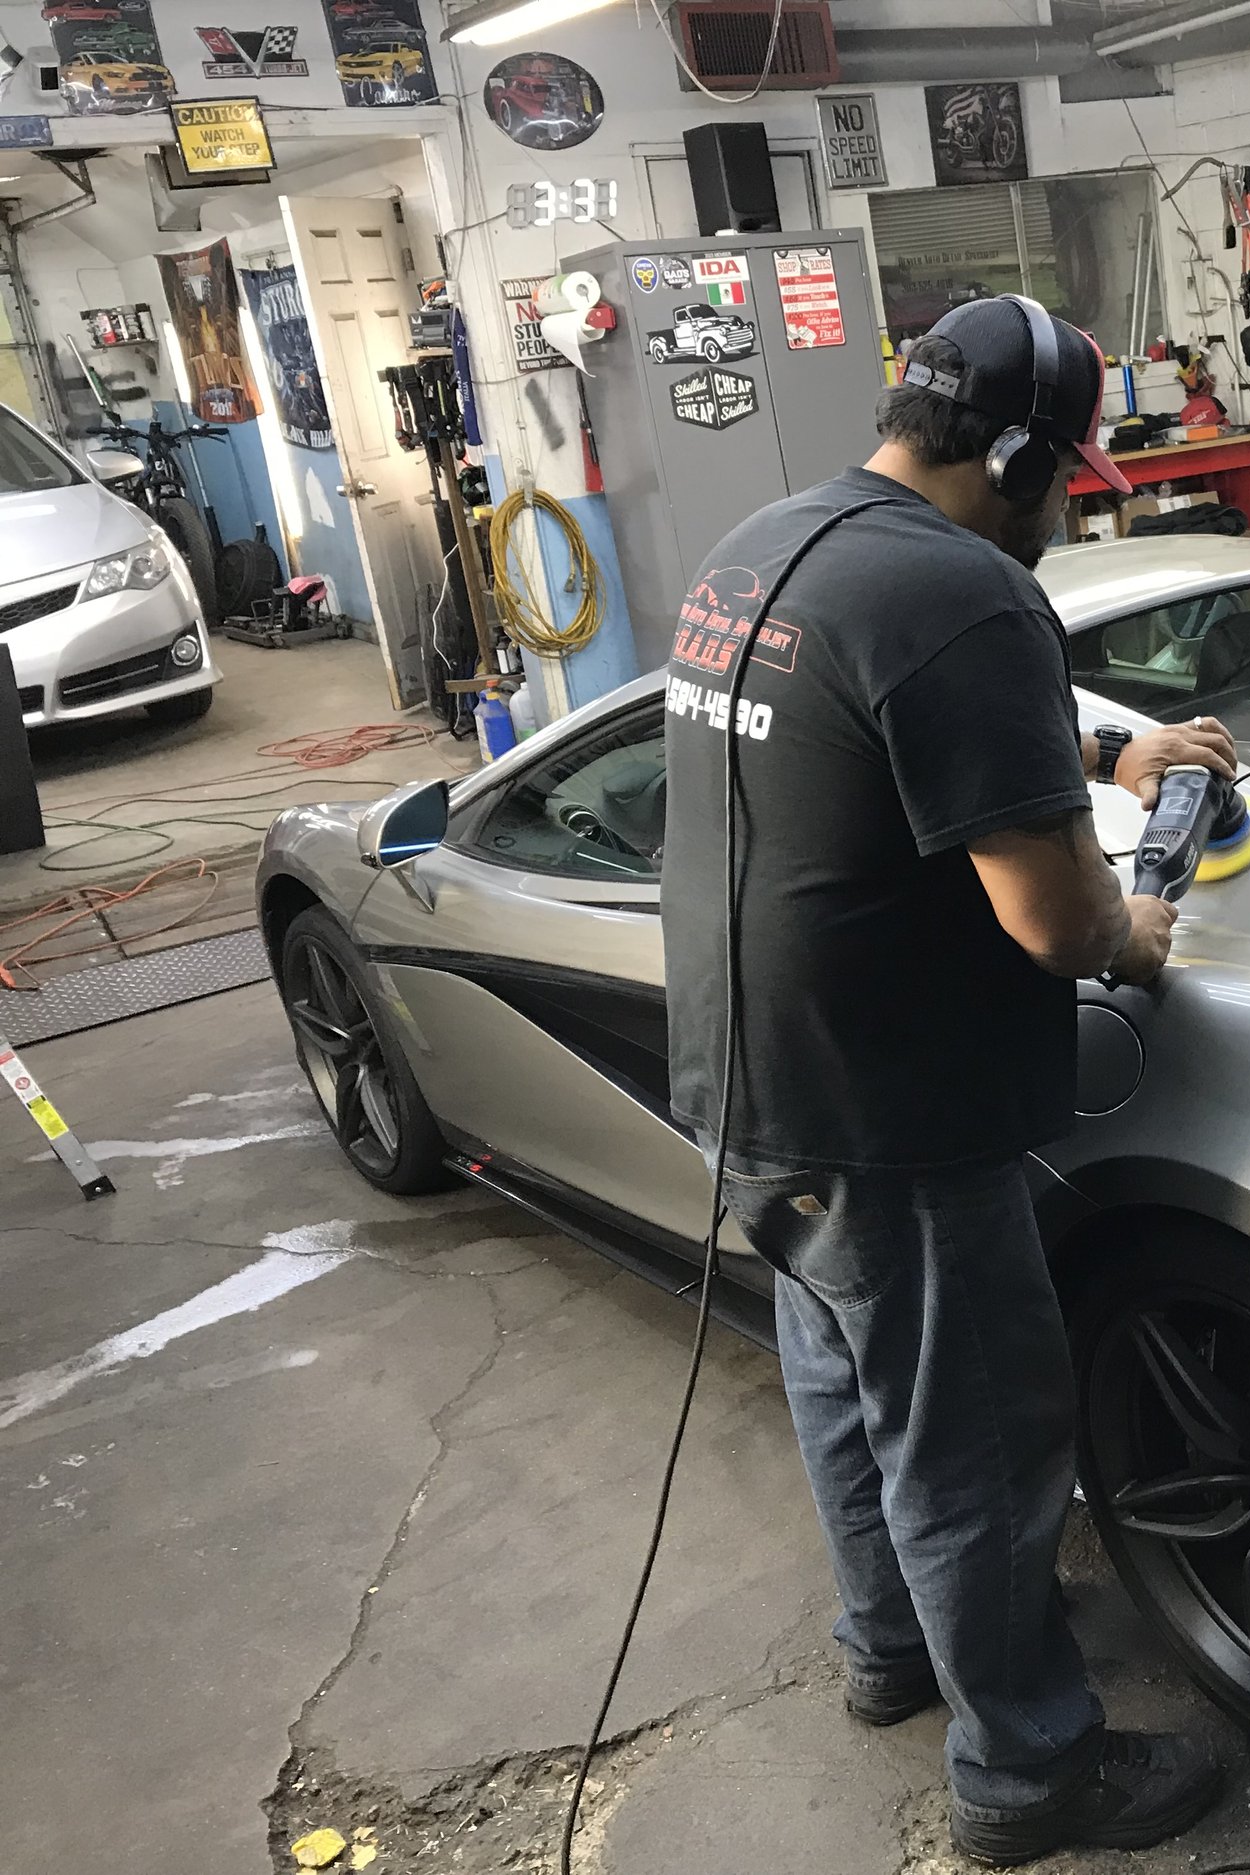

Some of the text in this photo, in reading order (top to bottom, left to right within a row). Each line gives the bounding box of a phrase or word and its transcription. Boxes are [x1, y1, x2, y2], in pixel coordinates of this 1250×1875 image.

[208, 64, 248, 75] 454
[831, 104, 864, 133] NO
[200, 128, 246, 143] WATCH
[829, 136, 876, 156] SPEED
[831, 156, 878, 180] LIMIT
[534, 178, 617, 227] 3:31
[699, 260, 741, 276] IDA
[503, 278, 545, 298] WARN
[515, 322, 541, 341] STU
[517, 339, 561, 358] PEOP
[674, 376, 708, 398] Skilled
[714, 373, 752, 396] CHEAP
[676, 401, 715, 424] CHEAP
[720, 399, 753, 421] Skilled
